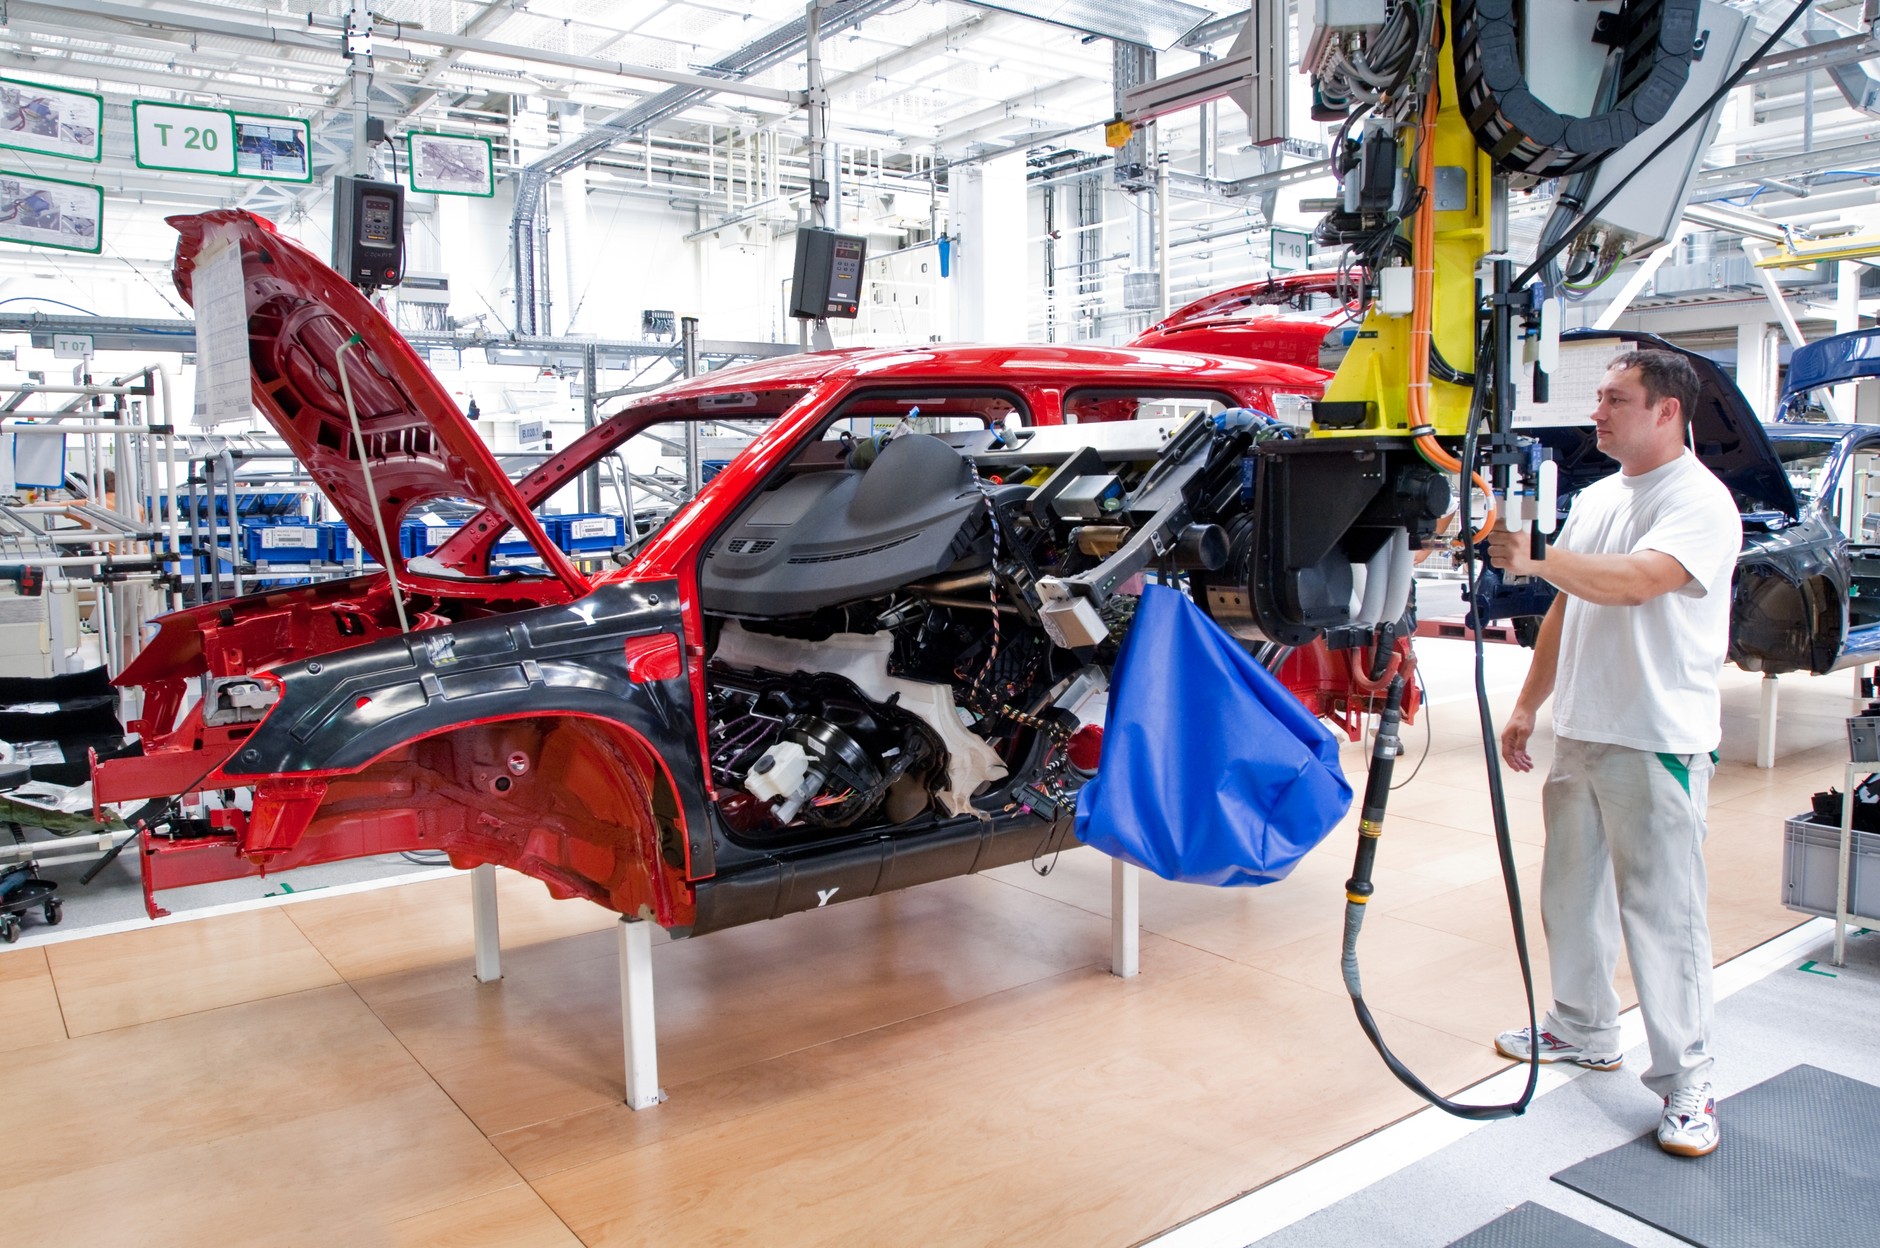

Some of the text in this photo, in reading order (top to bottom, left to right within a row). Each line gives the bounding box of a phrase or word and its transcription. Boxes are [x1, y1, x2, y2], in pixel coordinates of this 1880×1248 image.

[153, 123, 173, 147] T
[184, 126, 218, 152] 20
[1279, 242, 1301, 258] T 19
[60, 341, 86, 351] T 07
[568, 604, 596, 626] Y
[817, 887, 840, 907] Y
